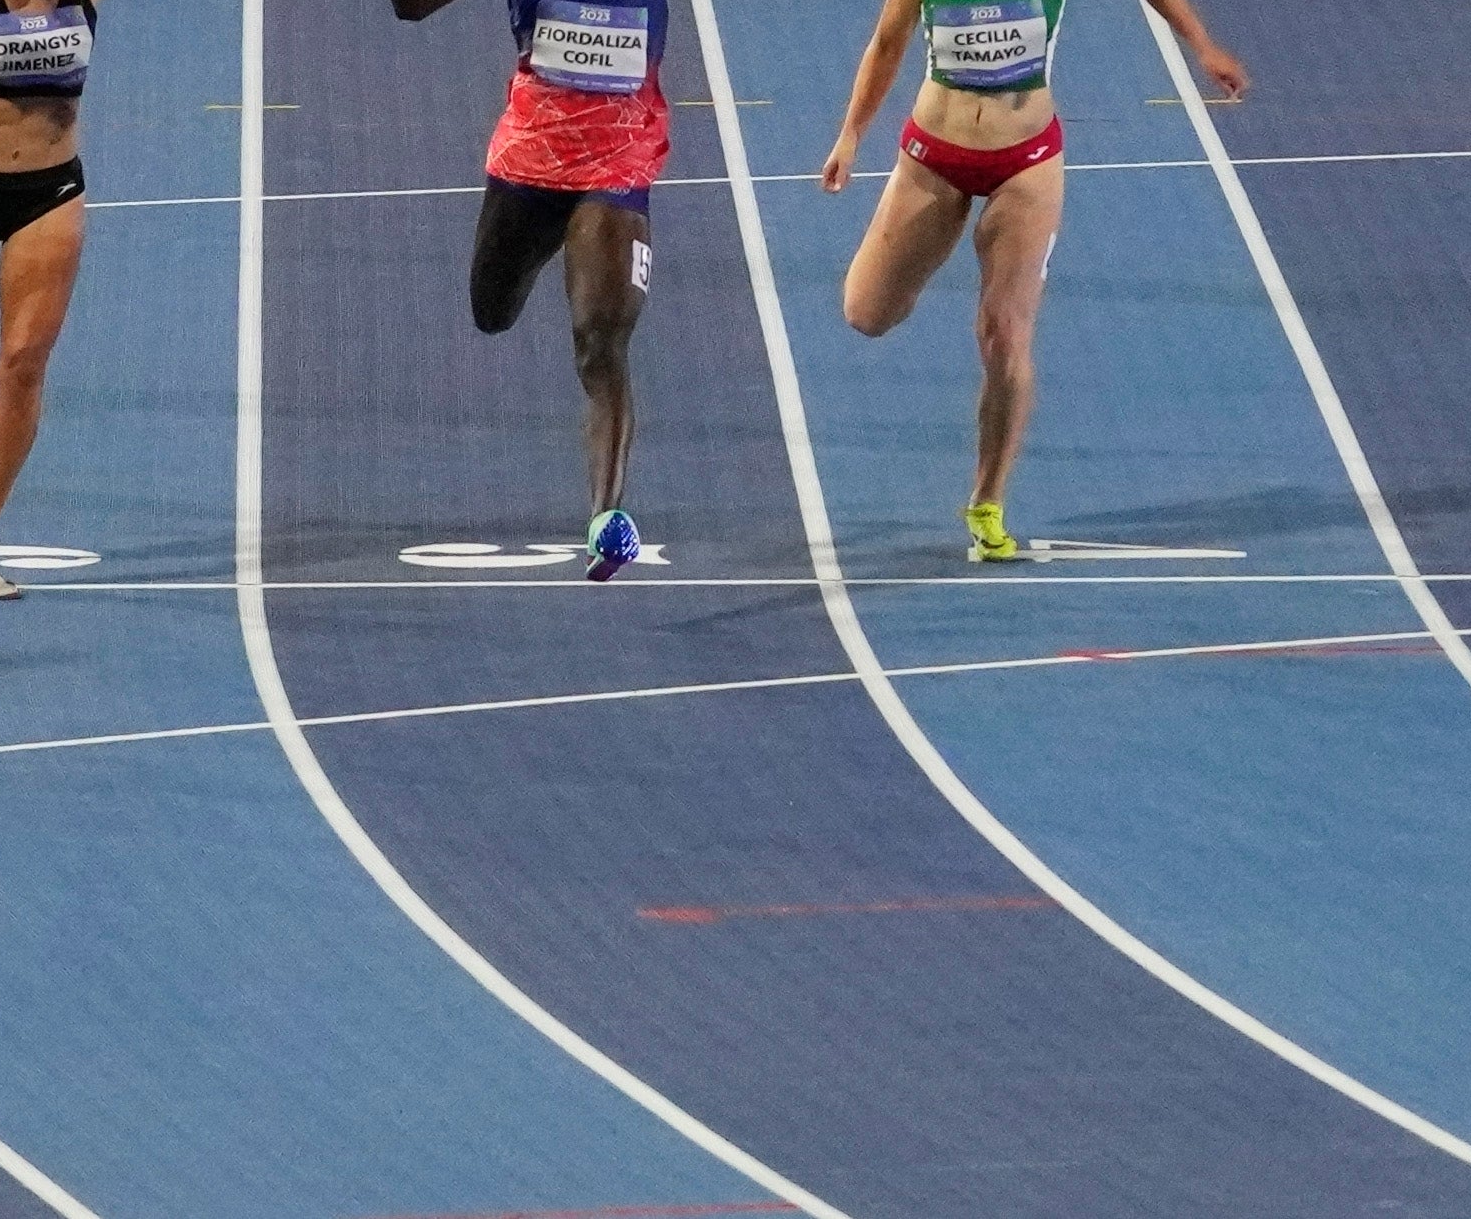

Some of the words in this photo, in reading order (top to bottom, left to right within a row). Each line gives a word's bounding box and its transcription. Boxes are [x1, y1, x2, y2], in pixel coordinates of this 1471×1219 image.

[579, 9, 610, 22] 2023
[971, 8, 1002, 20] 2023
[20, 17, 48, 30] 2023
[537, 26, 641, 50] FIORDALIZA
[954, 29, 1022, 46] CECILIA
[1, 53, 76, 72] JIMENEZ
[563, 50, 614, 67] COFIL
[952, 45, 1027, 63] TAMAYO
